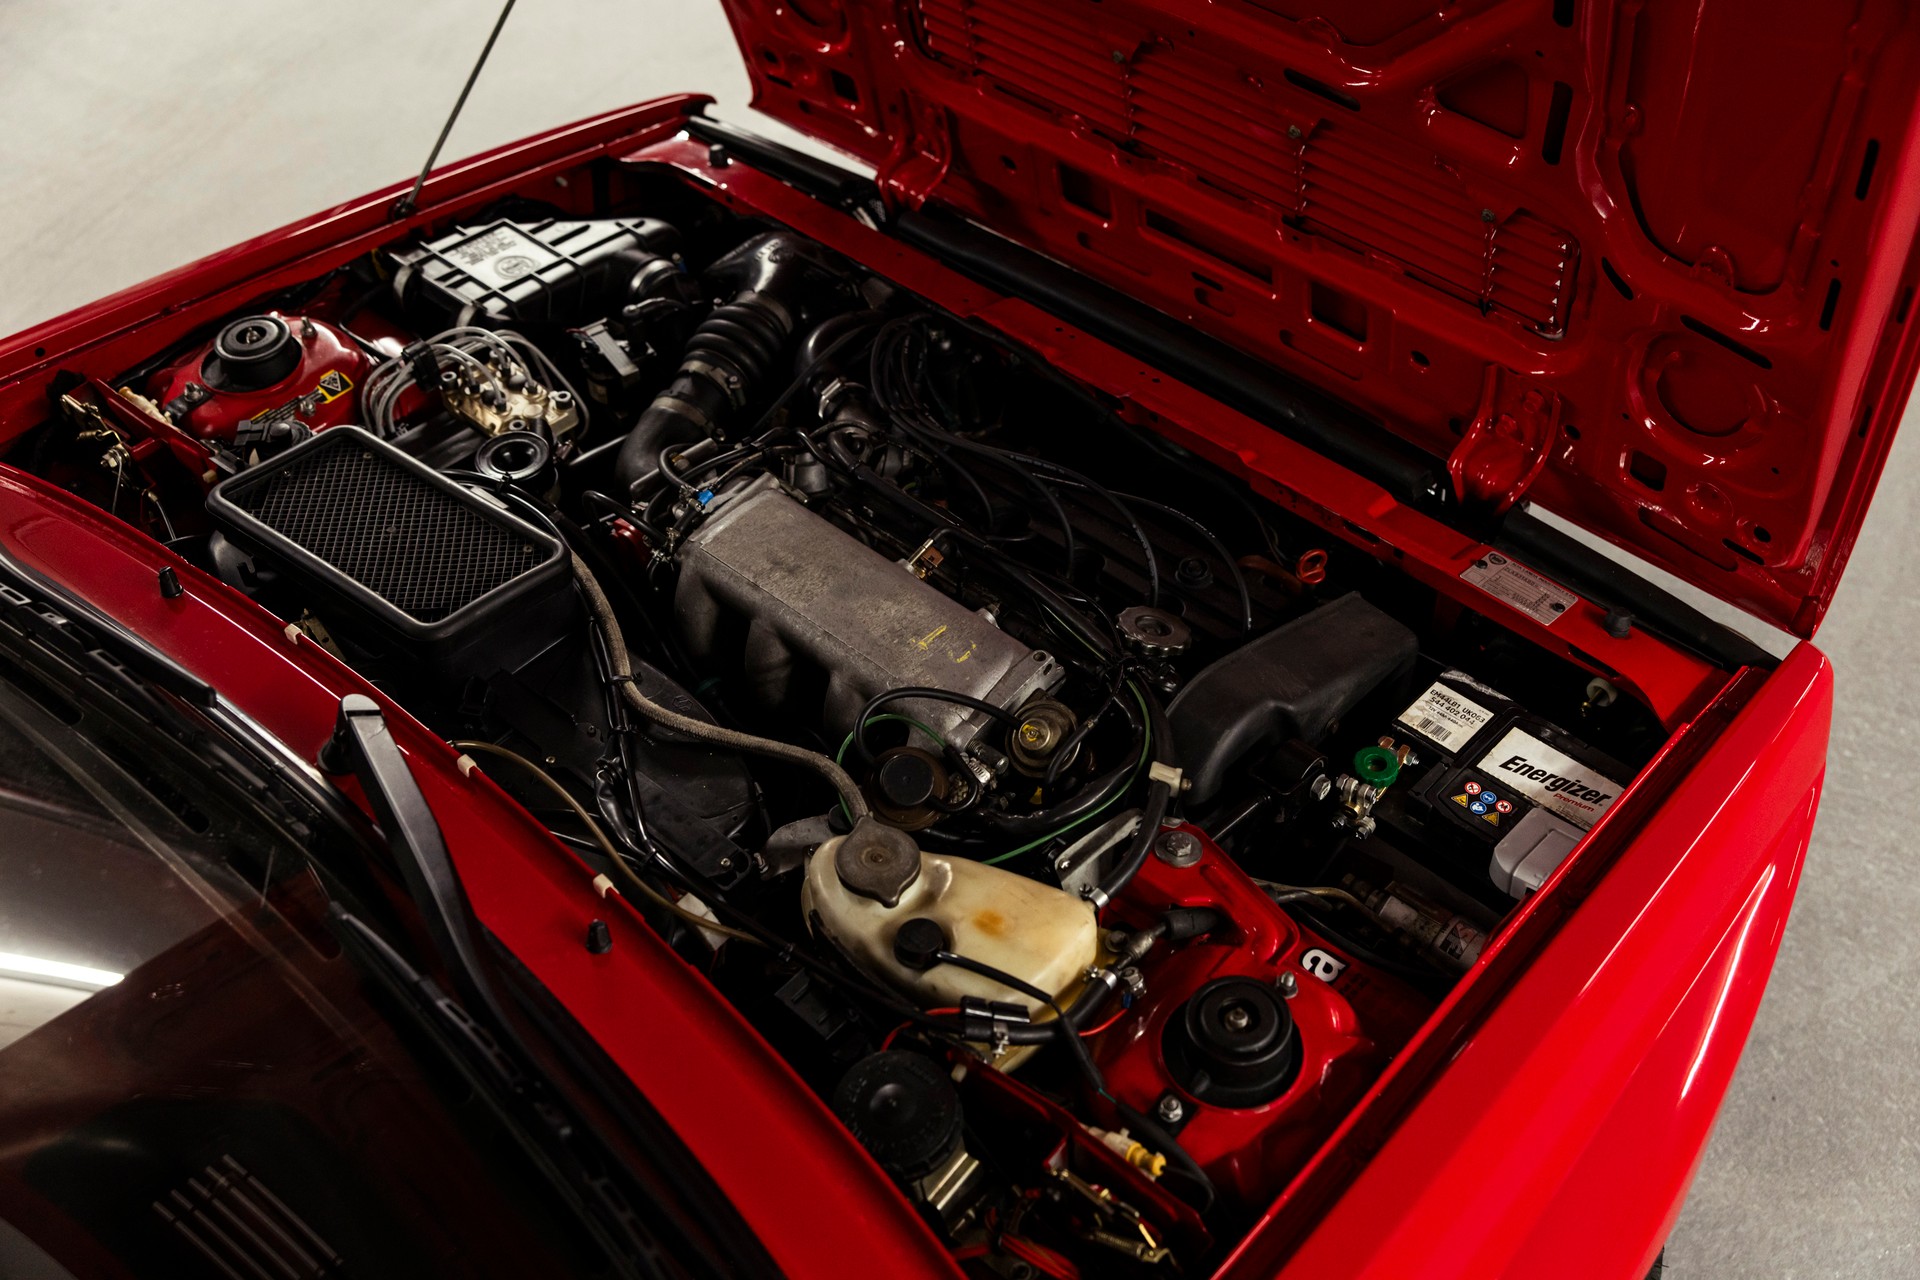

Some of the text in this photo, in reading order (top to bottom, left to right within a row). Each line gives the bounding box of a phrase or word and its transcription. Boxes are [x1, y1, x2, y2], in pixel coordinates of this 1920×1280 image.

[1430, 697, 1444, 707] 544
[1445, 705, 1460, 716] 402
[1499, 756, 1612, 804] Energizer
[1553, 793, 1594, 812] Premium
